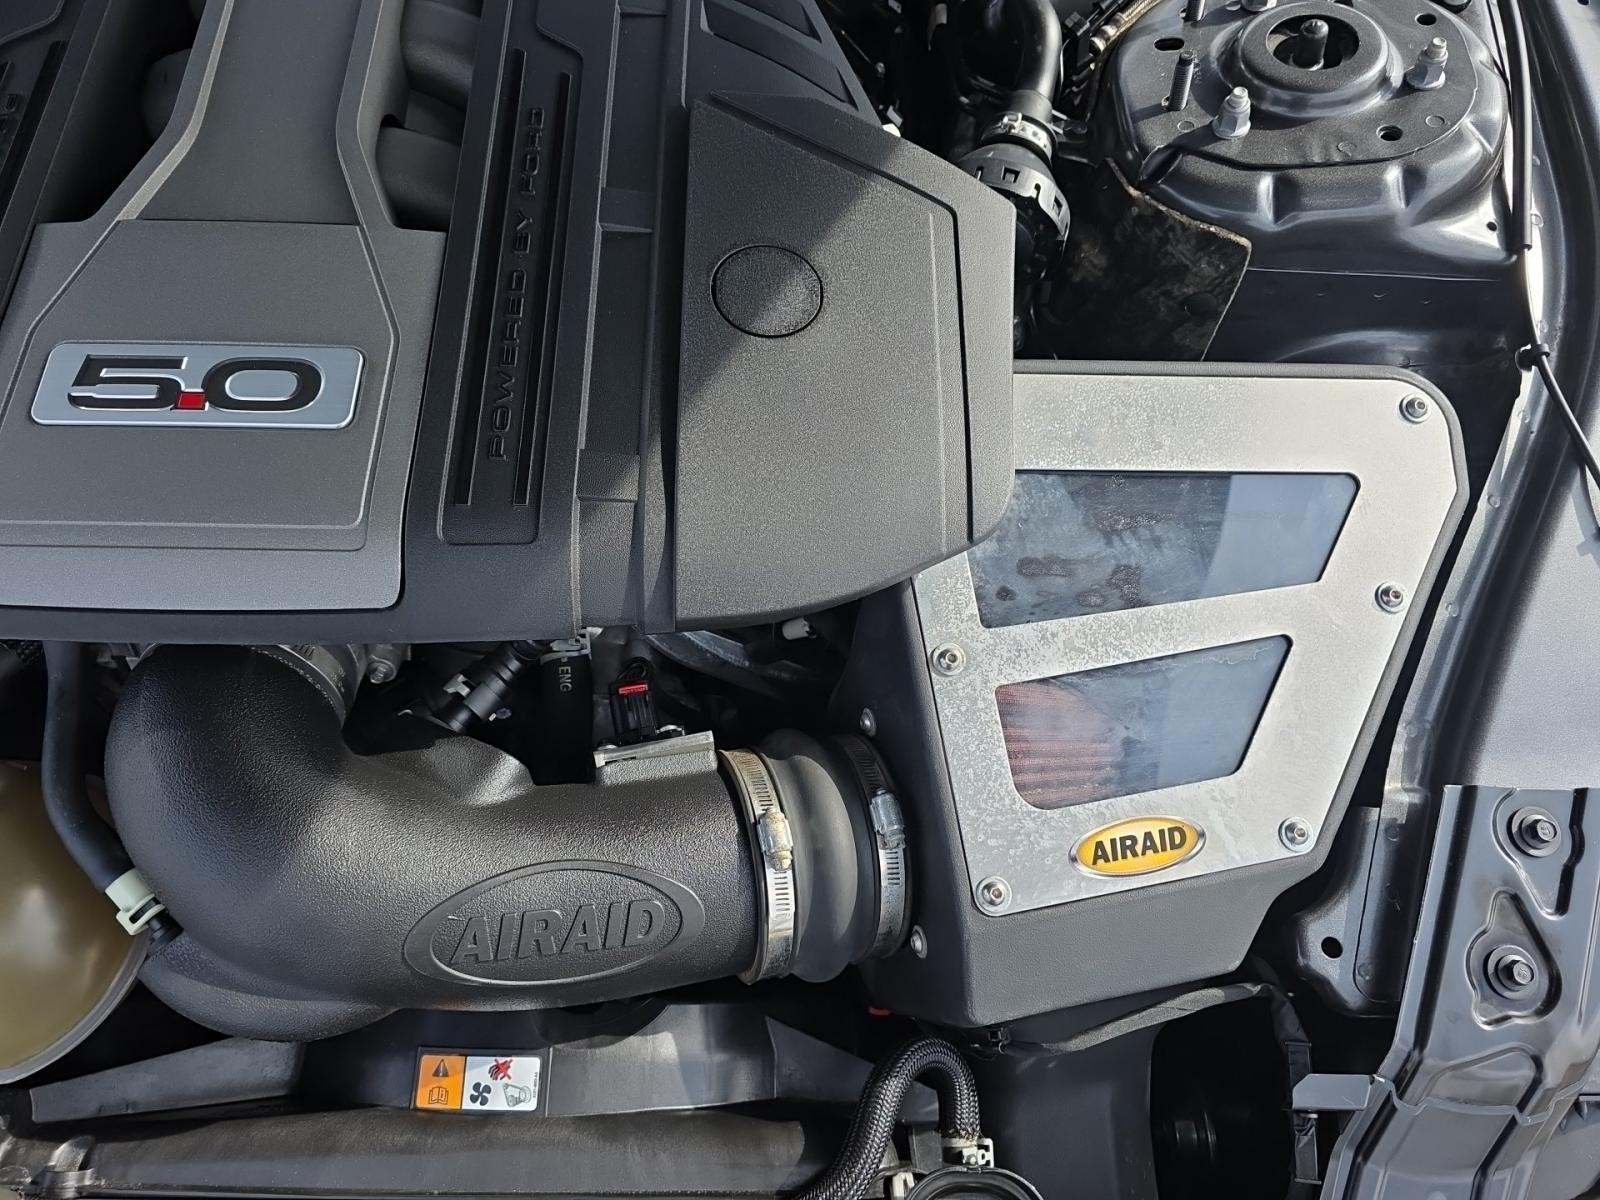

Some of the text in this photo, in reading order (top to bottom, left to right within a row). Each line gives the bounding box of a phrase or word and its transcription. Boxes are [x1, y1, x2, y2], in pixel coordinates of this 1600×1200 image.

[488, 107, 545, 461] POWERED BY FORD
[67, 354, 326, 412] 5.0
[1091, 825, 1187, 866] AIRAID
[450, 900, 666, 964] AIRAID
